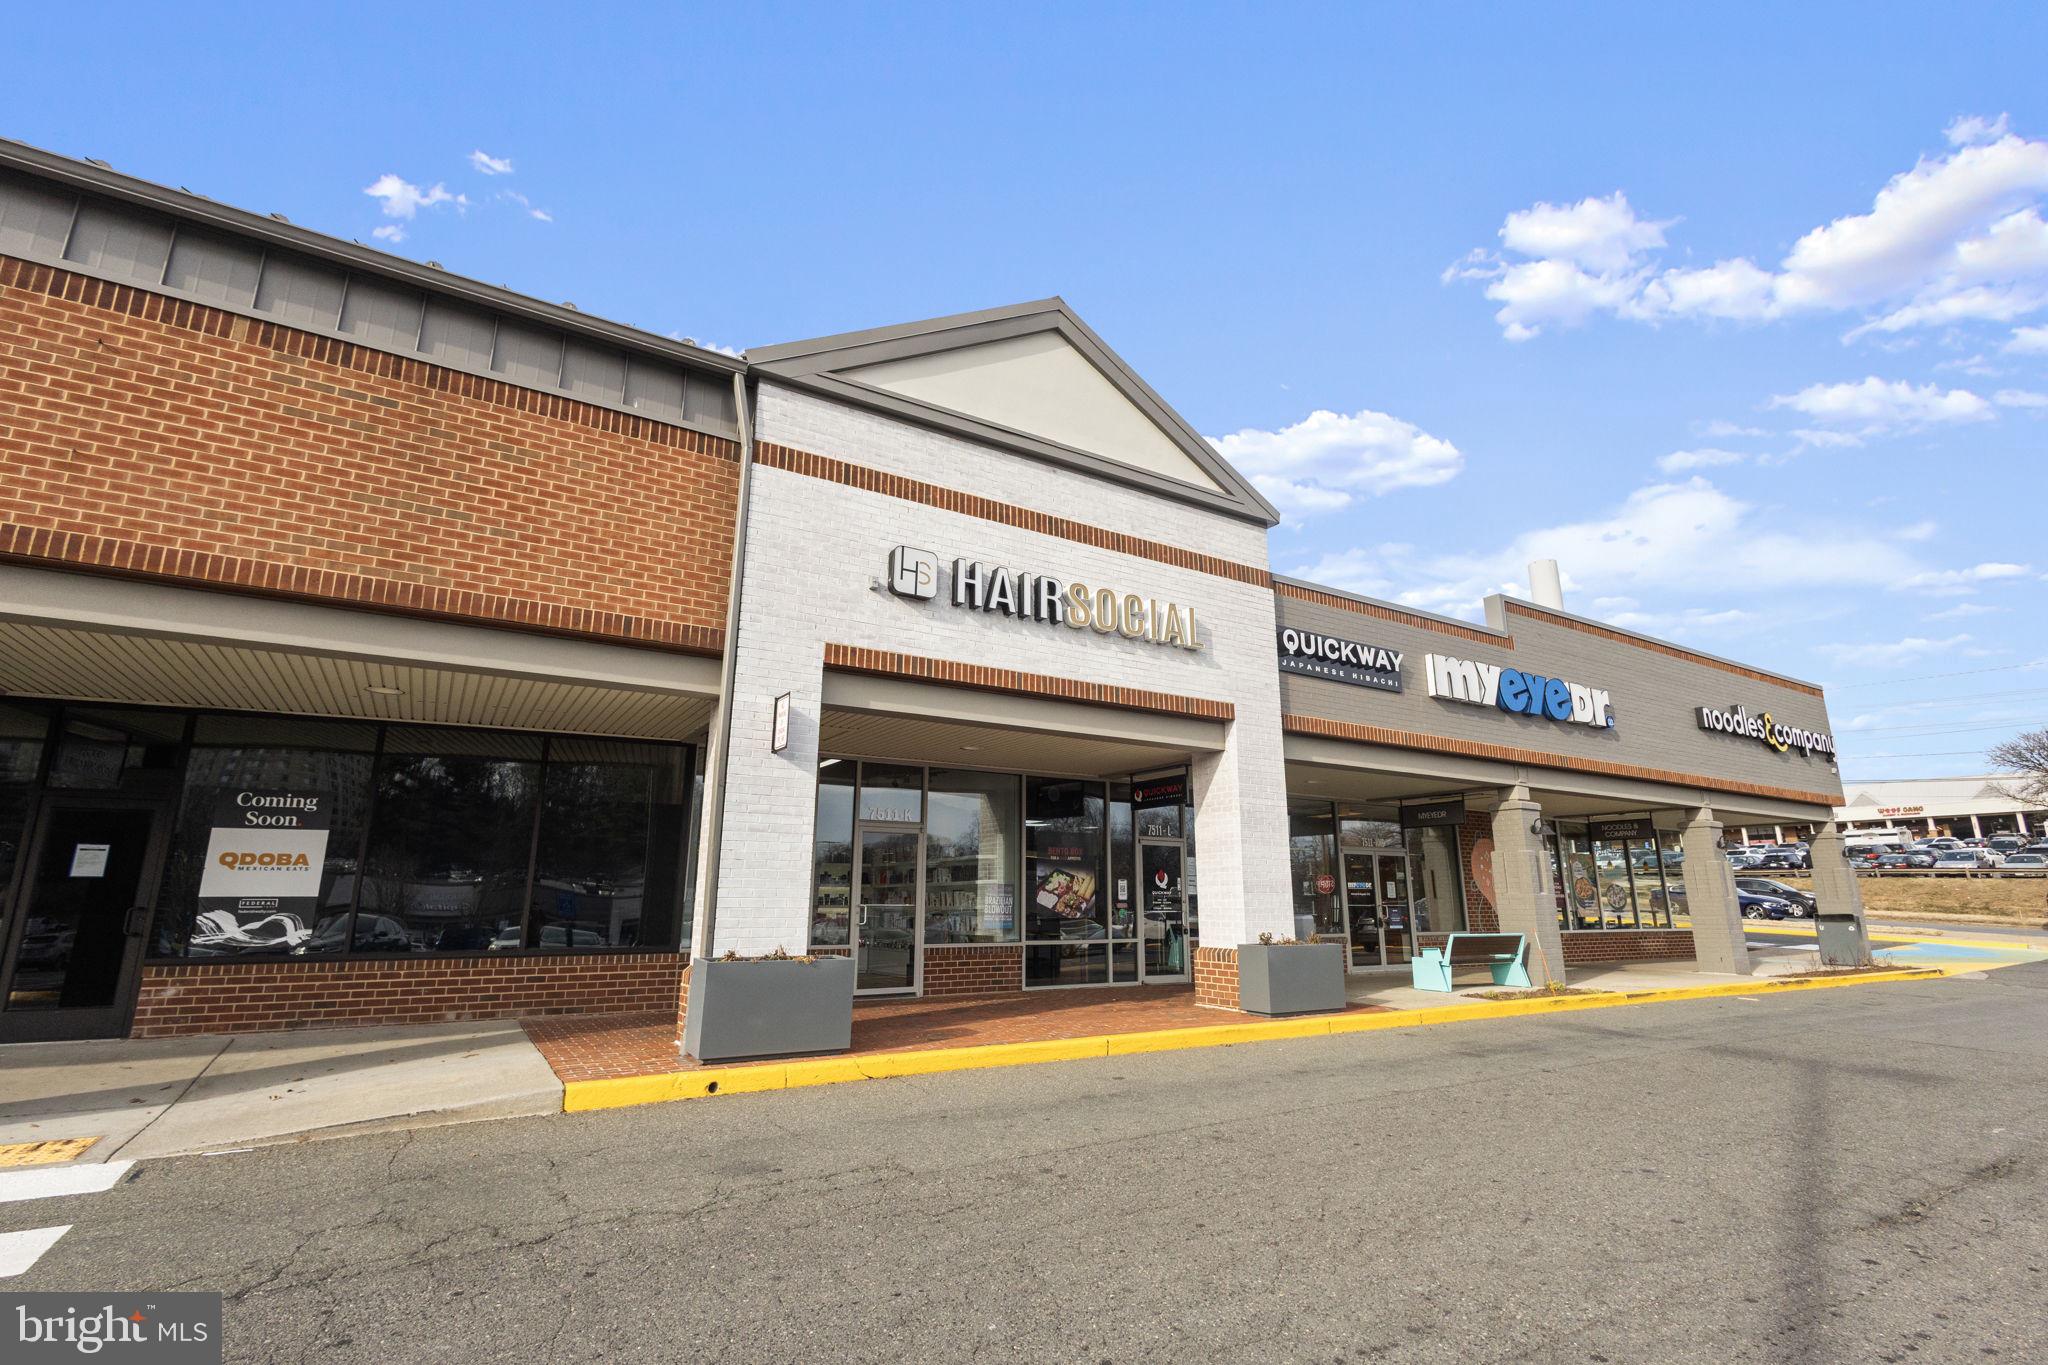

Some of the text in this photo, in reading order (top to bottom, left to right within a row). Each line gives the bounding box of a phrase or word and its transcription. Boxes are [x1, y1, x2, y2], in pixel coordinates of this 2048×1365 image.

[1282, 628, 1404, 672] QUICKWAY
[1282, 659, 1399, 687] JAPANESE HIBACHI
[237, 792, 319, 811] Coming
[1601, 823, 1632, 831] NOODLES
[1604, 830, 1637, 838] COMPANY
[219, 851, 310, 870] QDOBA
[984, 904, 1013, 914] BLOWOUT
